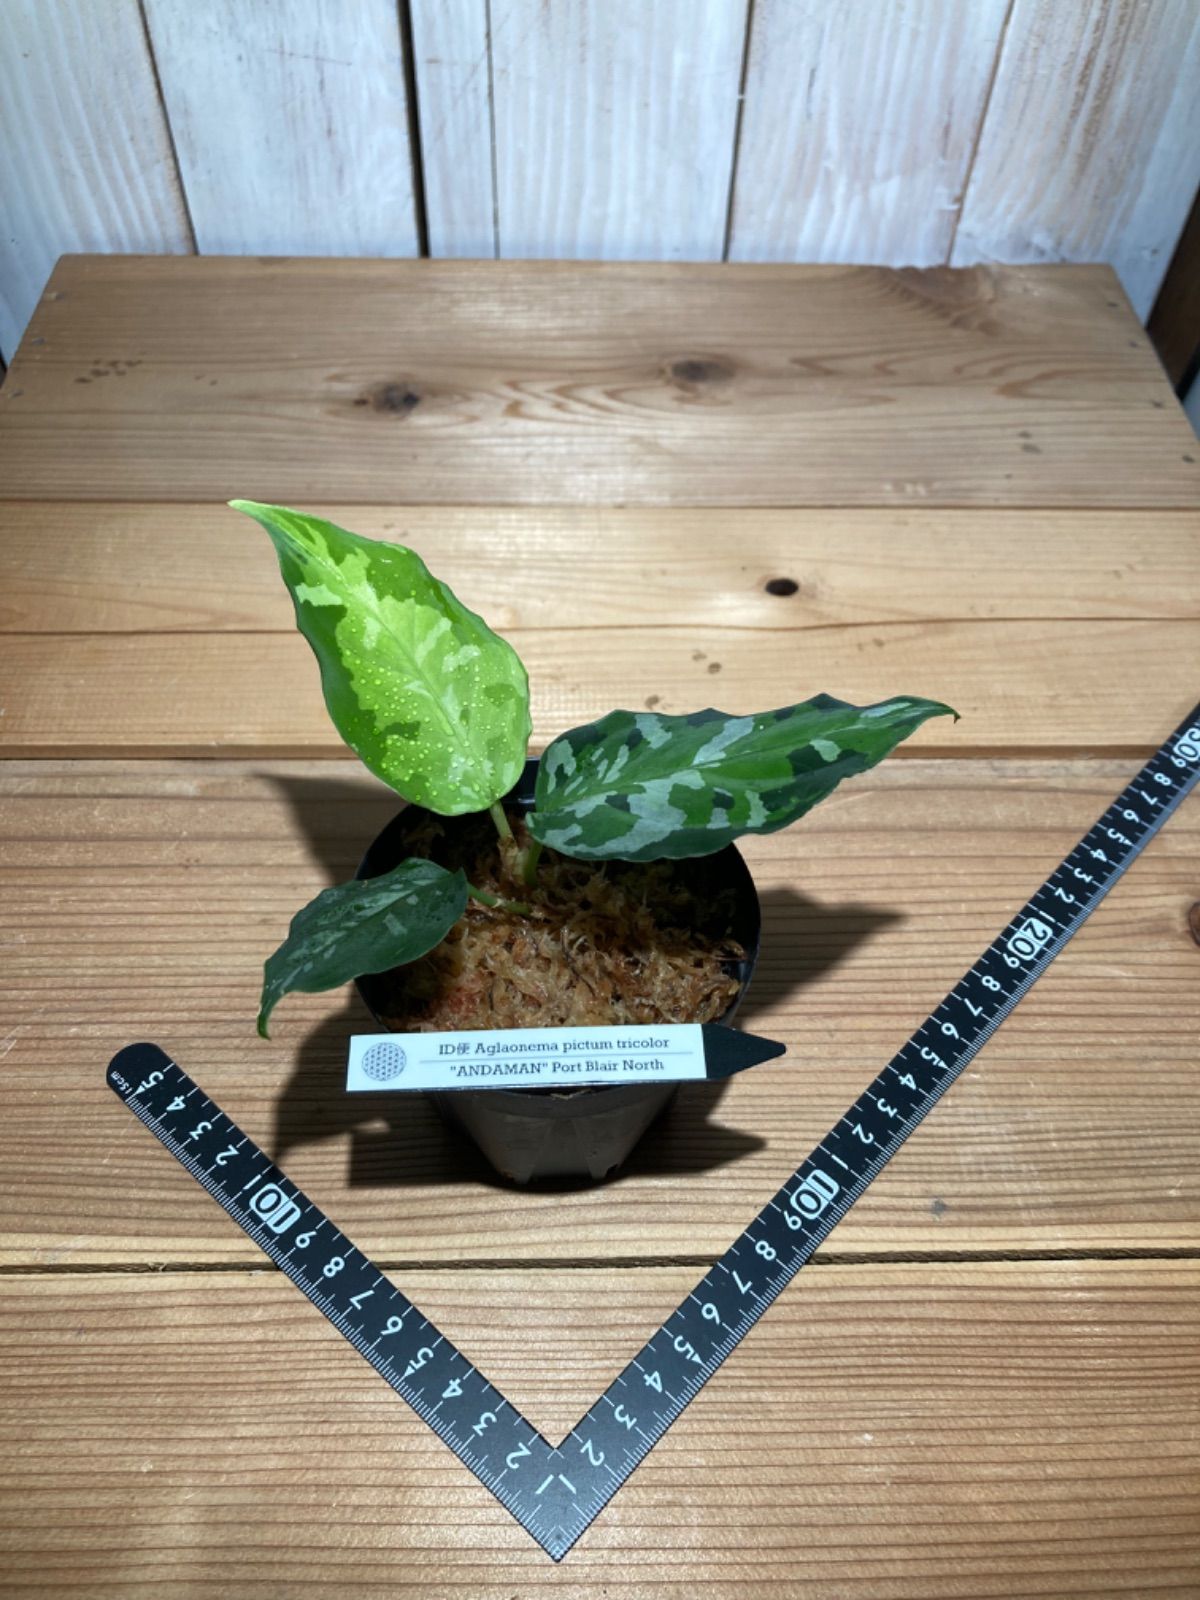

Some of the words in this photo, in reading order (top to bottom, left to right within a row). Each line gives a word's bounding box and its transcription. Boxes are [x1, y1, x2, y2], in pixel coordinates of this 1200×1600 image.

[1170, 755, 1186, 768] 9
[1154, 773, 1172, 787] 8
[1141, 791, 1158, 805] 7
[1123, 809, 1140, 822] 6
[1107, 828, 1125, 843] 5
[1091, 849, 1107, 862] 4
[1074, 868, 1093, 883] 3
[1055, 887, 1075, 903] 2
[1039, 910, 1056, 923] 1
[1012, 919, 1049, 957] 20
[1003, 953, 1020, 968] 9
[981, 975, 1001, 991] 8
[964, 998, 983, 1016] 7
[941, 1022, 960, 1040] 6
[475, 1041, 558, 1056] Aglaonema
[563, 1040, 613, 1053] pictum
[617, 1037, 669, 1049] tricolor
[921, 1047, 940, 1066] 5
[450, 1062, 548, 1077] "ANDAMAN"
[552, 1061, 582, 1073] Port
[585, 1060, 619, 1072] Blair
[623, 1058, 665, 1071] North
[898, 1073, 917, 1090] 4
[877, 1098, 898, 1118] 3
[852, 1123, 874, 1144] 2
[831, 1154, 848, 1170] 1
[798, 1173, 837, 1215] 10
[784, 1210, 802, 1231] 9
[755, 1240, 776, 1261] 8
[111, 1071, 133, 1094] 15cm
[141, 1071, 164, 1088] 5
[166, 1095, 186, 1111] 4
[190, 1121, 212, 1140] 3
[215, 1144, 240, 1166] 2
[243, 1174, 262, 1190] 1
[254, 1186, 299, 1230] 10
[295, 1230, 317, 1248] 9
[323, 1256, 345, 1278] 8
[350, 1289, 375, 1310] 7
[381, 1315, 403, 1336] 6
[410, 1347, 434, 1369] 5
[441, 1377, 463, 1399] 4
[472, 1411, 497, 1436] 3
[506, 1442, 532, 1469] 2
[535, 1474, 554, 1494] 1
[732, 1270, 752, 1294] 7
[701, 1303, 720, 1325] 6
[674, 1335, 695, 1360] 5
[644, 1371, 663, 1393] 4
[614, 1404, 637, 1429] 3
[580, 1439, 605, 1466] 2
[558, 1474, 577, 1494] 1
